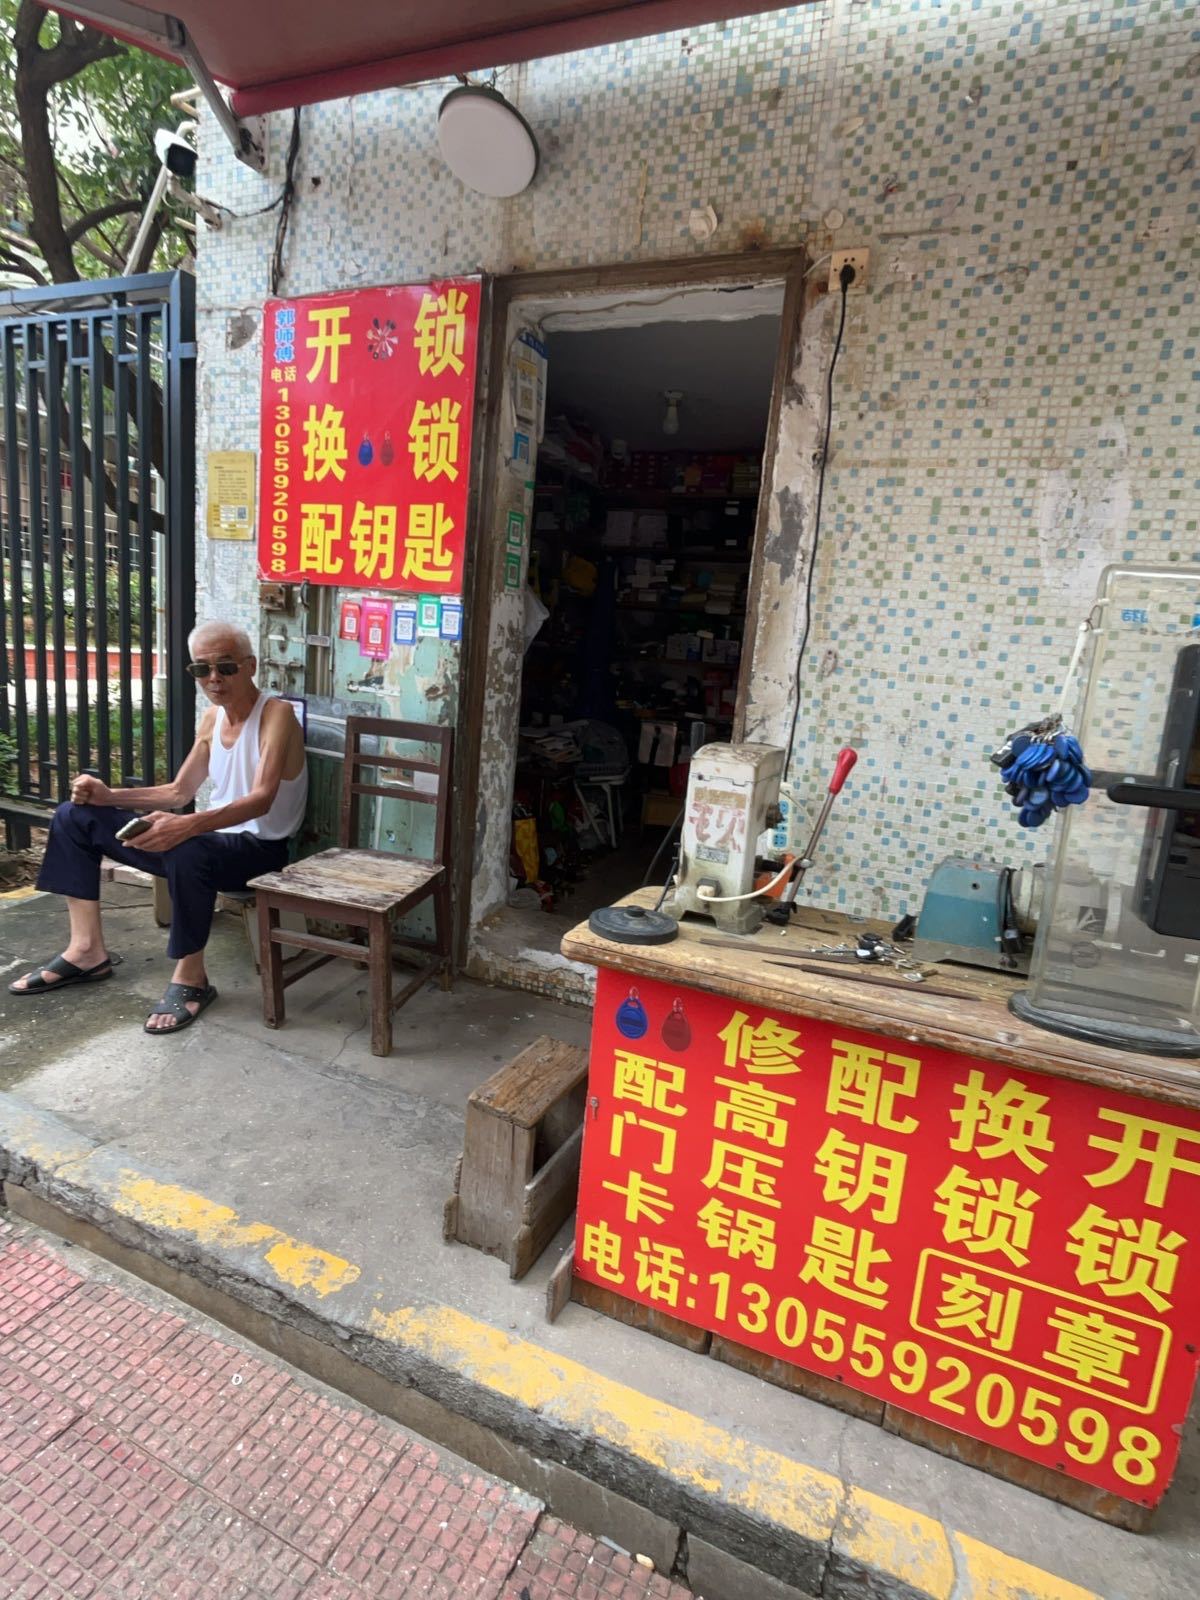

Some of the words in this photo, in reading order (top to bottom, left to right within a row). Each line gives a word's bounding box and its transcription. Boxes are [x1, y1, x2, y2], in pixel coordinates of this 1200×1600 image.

[271, 366, 297, 383] 电话
[273, 309, 296, 363] 郭师傅
[270, 388, 292, 573] 13055920598
[299, 501, 455, 582] 配钥匙
[602, 1048, 687, 1225] 配门卡
[697, 1010, 805, 1271] 修高压锅
[799, 1038, 921, 1311] 配钥匙
[933, 1070, 1054, 1268] 换锁
[1065, 1106, 1200, 1313] 开锁
[934, 1271, 1142, 1391] 刻章
